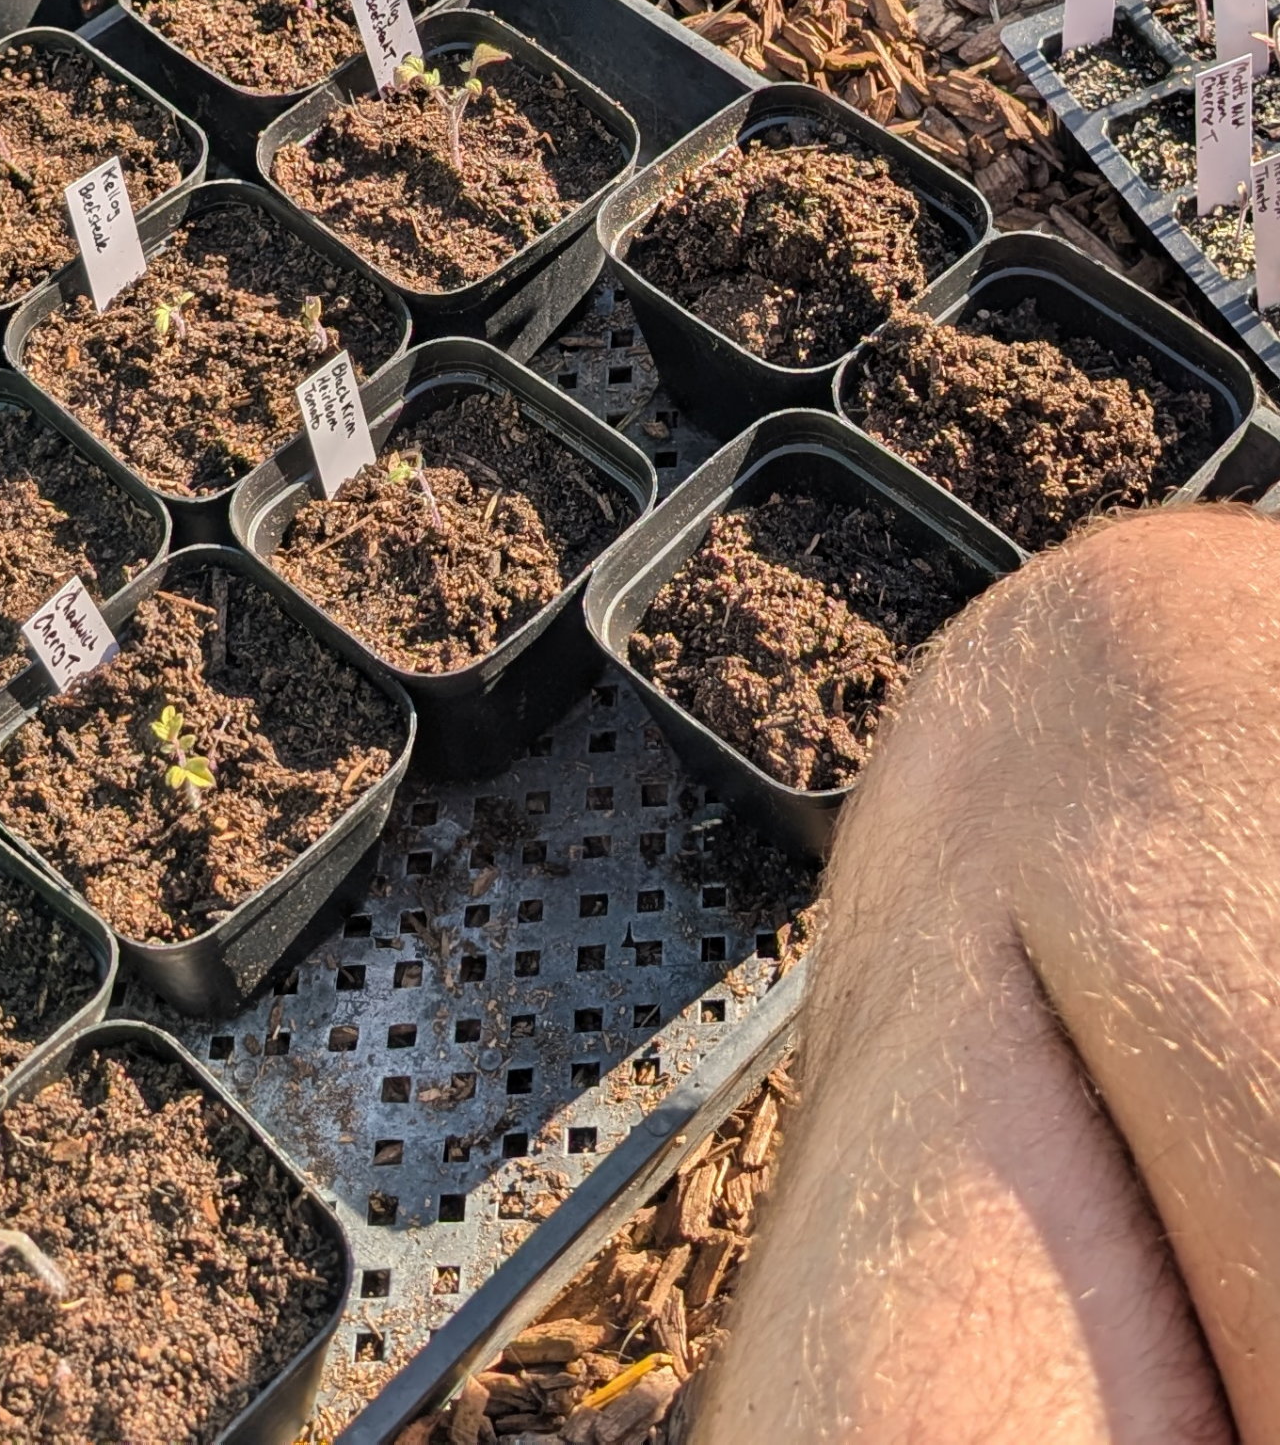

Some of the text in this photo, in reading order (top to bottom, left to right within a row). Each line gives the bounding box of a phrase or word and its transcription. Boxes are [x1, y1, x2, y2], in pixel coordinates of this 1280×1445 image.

[77, 181, 111, 255] Beefsteak
[100, 165, 122, 224] Kellog
[303, 382, 322, 432] Tomato
[316, 374, 339, 433] Heirloom
[330, 361, 356, 440] Black Krim
[32, 613, 82, 674] Cherry T.
